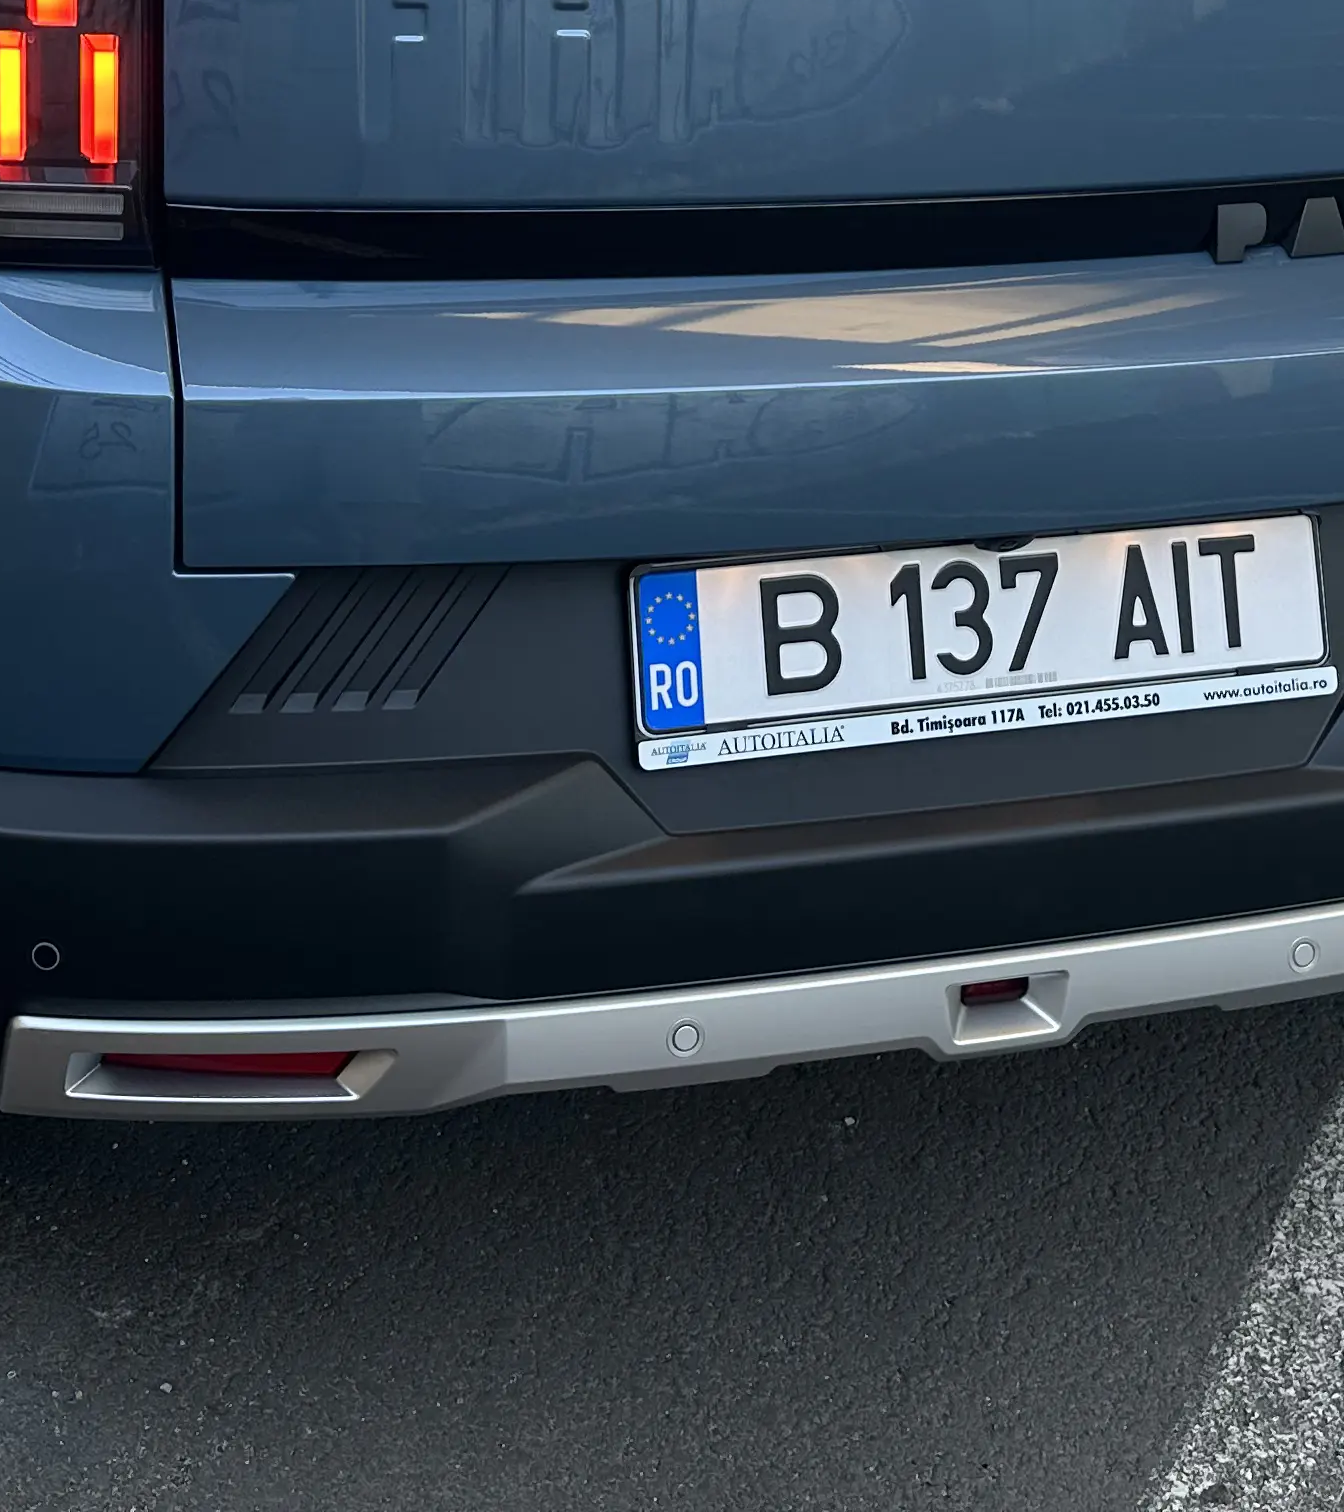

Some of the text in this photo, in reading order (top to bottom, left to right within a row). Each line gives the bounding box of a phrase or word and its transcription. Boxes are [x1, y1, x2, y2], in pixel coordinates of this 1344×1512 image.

[759, 534, 1256, 697] B 137 AIT
[650, 661, 699, 710] RO
[890, 718, 914, 736] Bd.
[991, 707, 1025, 725] 117A
[1038, 702, 1063, 720] Tel:
[1066, 692, 1161, 717] 021.455.03.50
[1203, 677, 1328, 701] www.autoitalia.ro
